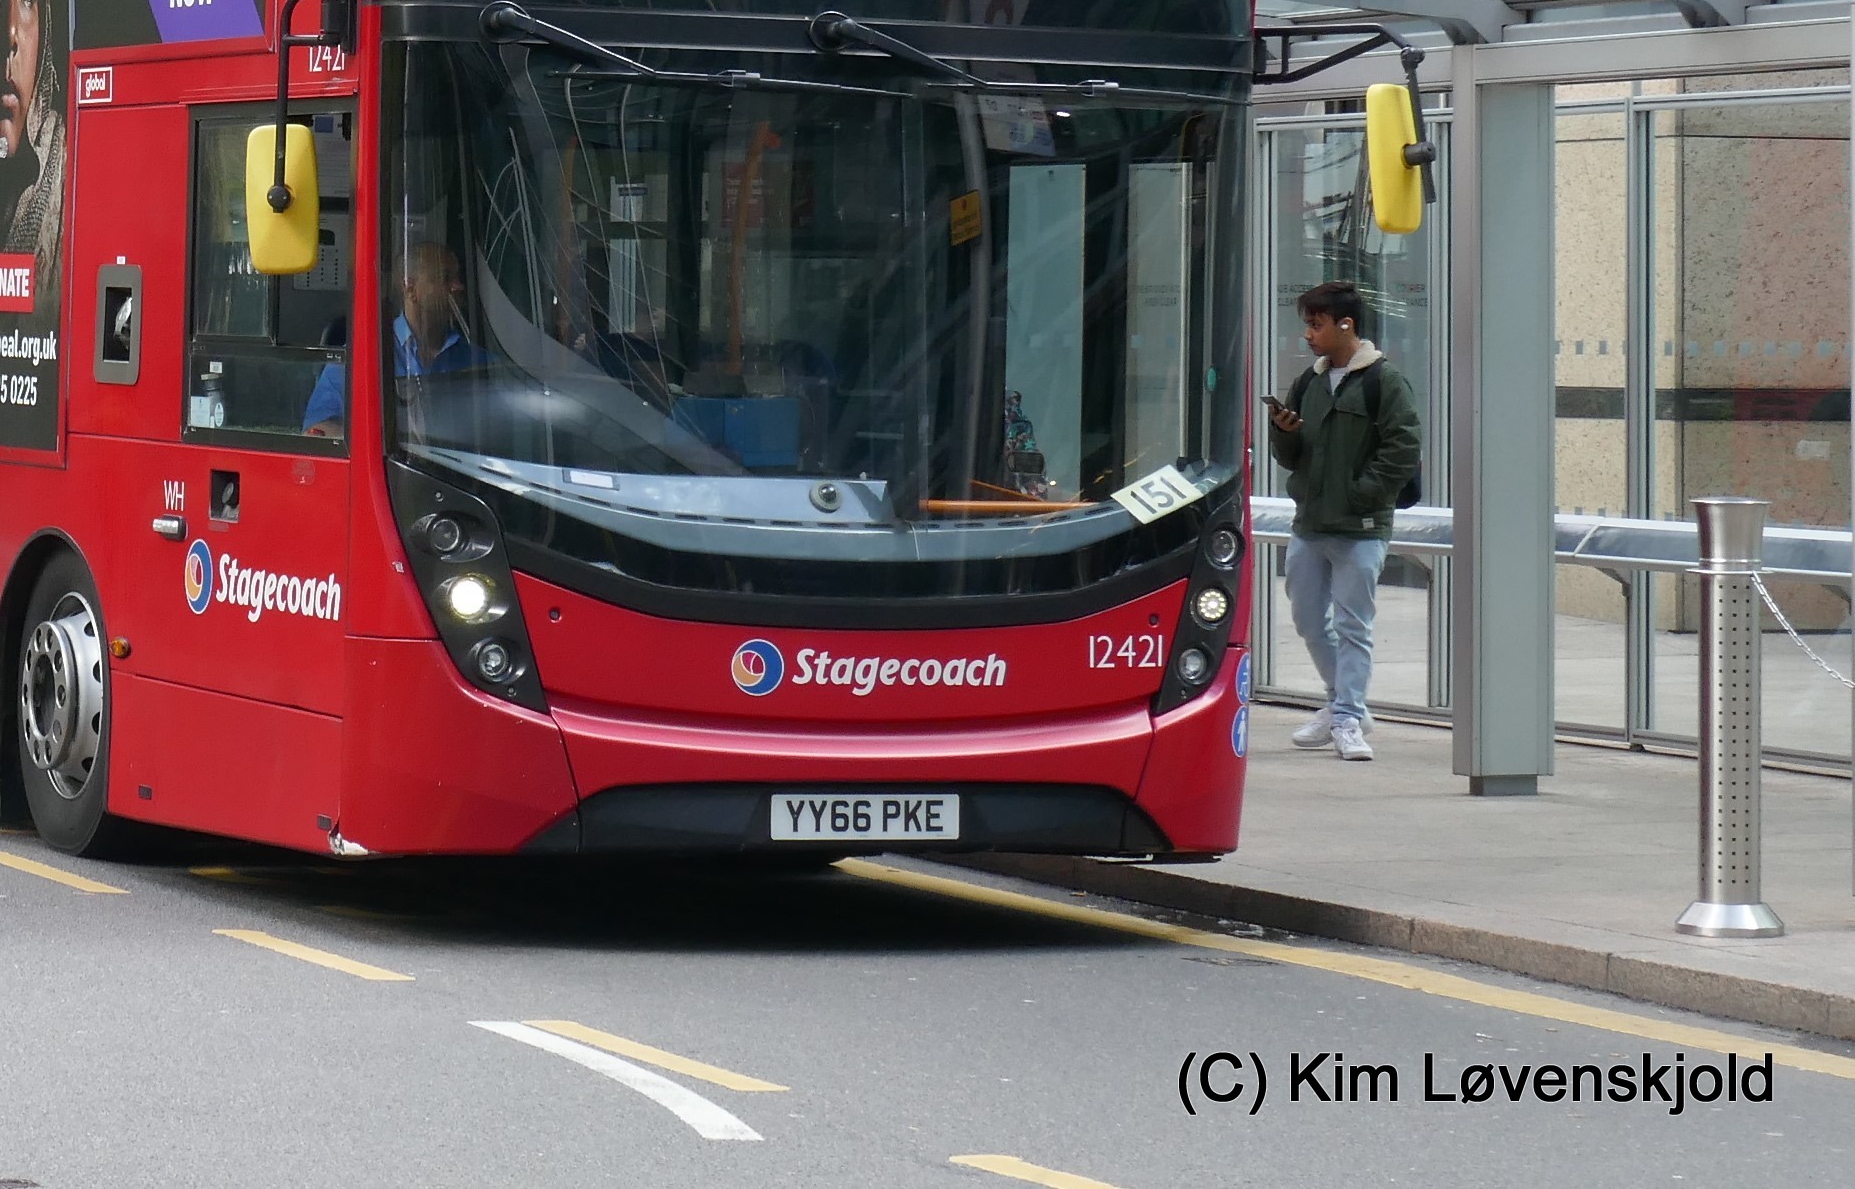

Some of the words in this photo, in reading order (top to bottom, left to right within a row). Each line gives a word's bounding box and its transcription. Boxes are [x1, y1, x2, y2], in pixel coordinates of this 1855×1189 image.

[309, 45, 345, 72] 12421
[85, 72, 105, 98] global
[10, 375, 38, 406] 0225
[163, 480, 185, 511] WH
[1130, 476, 1187, 515] 151
[216, 553, 341, 623] Stagecoach
[1089, 635, 1163, 668] 12421
[791, 648, 1007, 696] Stagecoach
[786, 800, 872, 833] YY66
[882, 800, 944, 832] PKE
